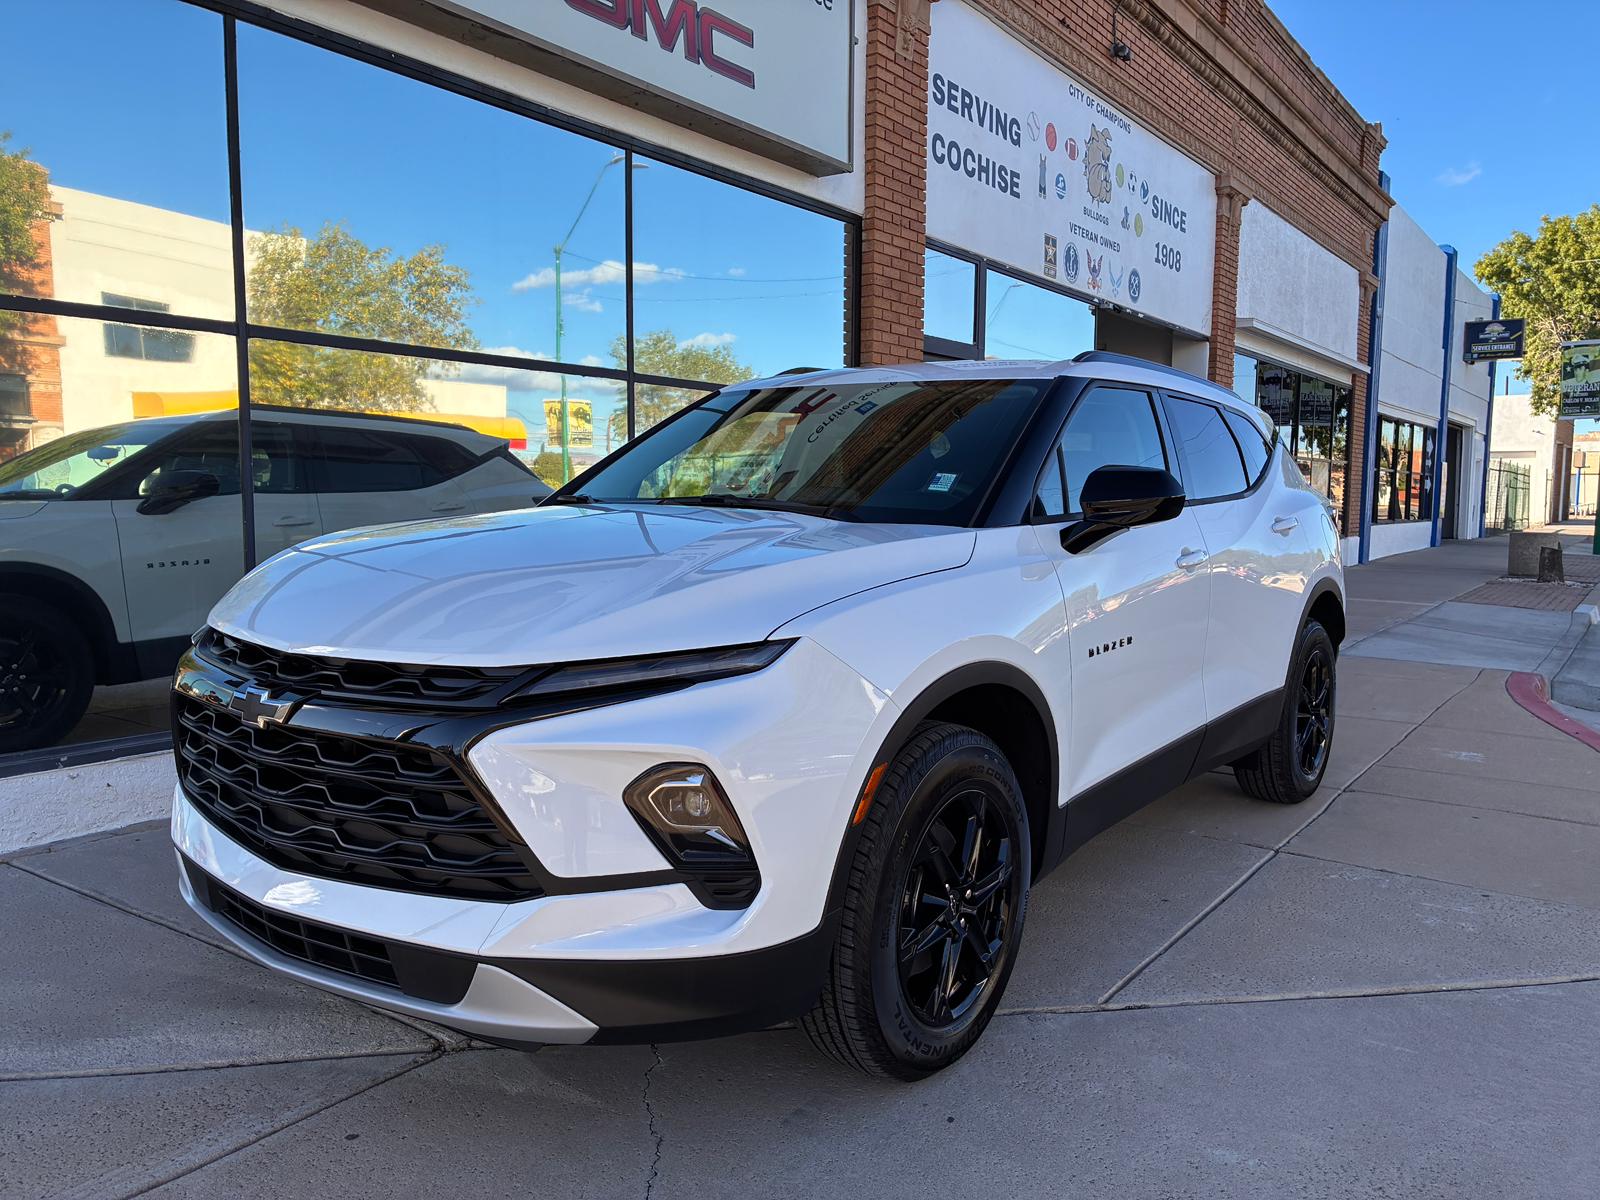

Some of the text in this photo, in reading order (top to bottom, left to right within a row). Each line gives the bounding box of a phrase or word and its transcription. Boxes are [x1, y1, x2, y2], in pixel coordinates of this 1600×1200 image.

[932, 73, 1021, 148] SERVING
[1068, 84, 1132, 134] CITY OF CHAMPIONS
[931, 133, 1021, 199] COCHISE
[1083, 206, 1109, 226] BULLDOGS
[1151, 194, 1187, 234] SINCE
[1069, 221, 1121, 253] VETERAN OWNED
[1154, 242, 1182, 272] 1908
[1088, 635, 1133, 659] BLAZER
